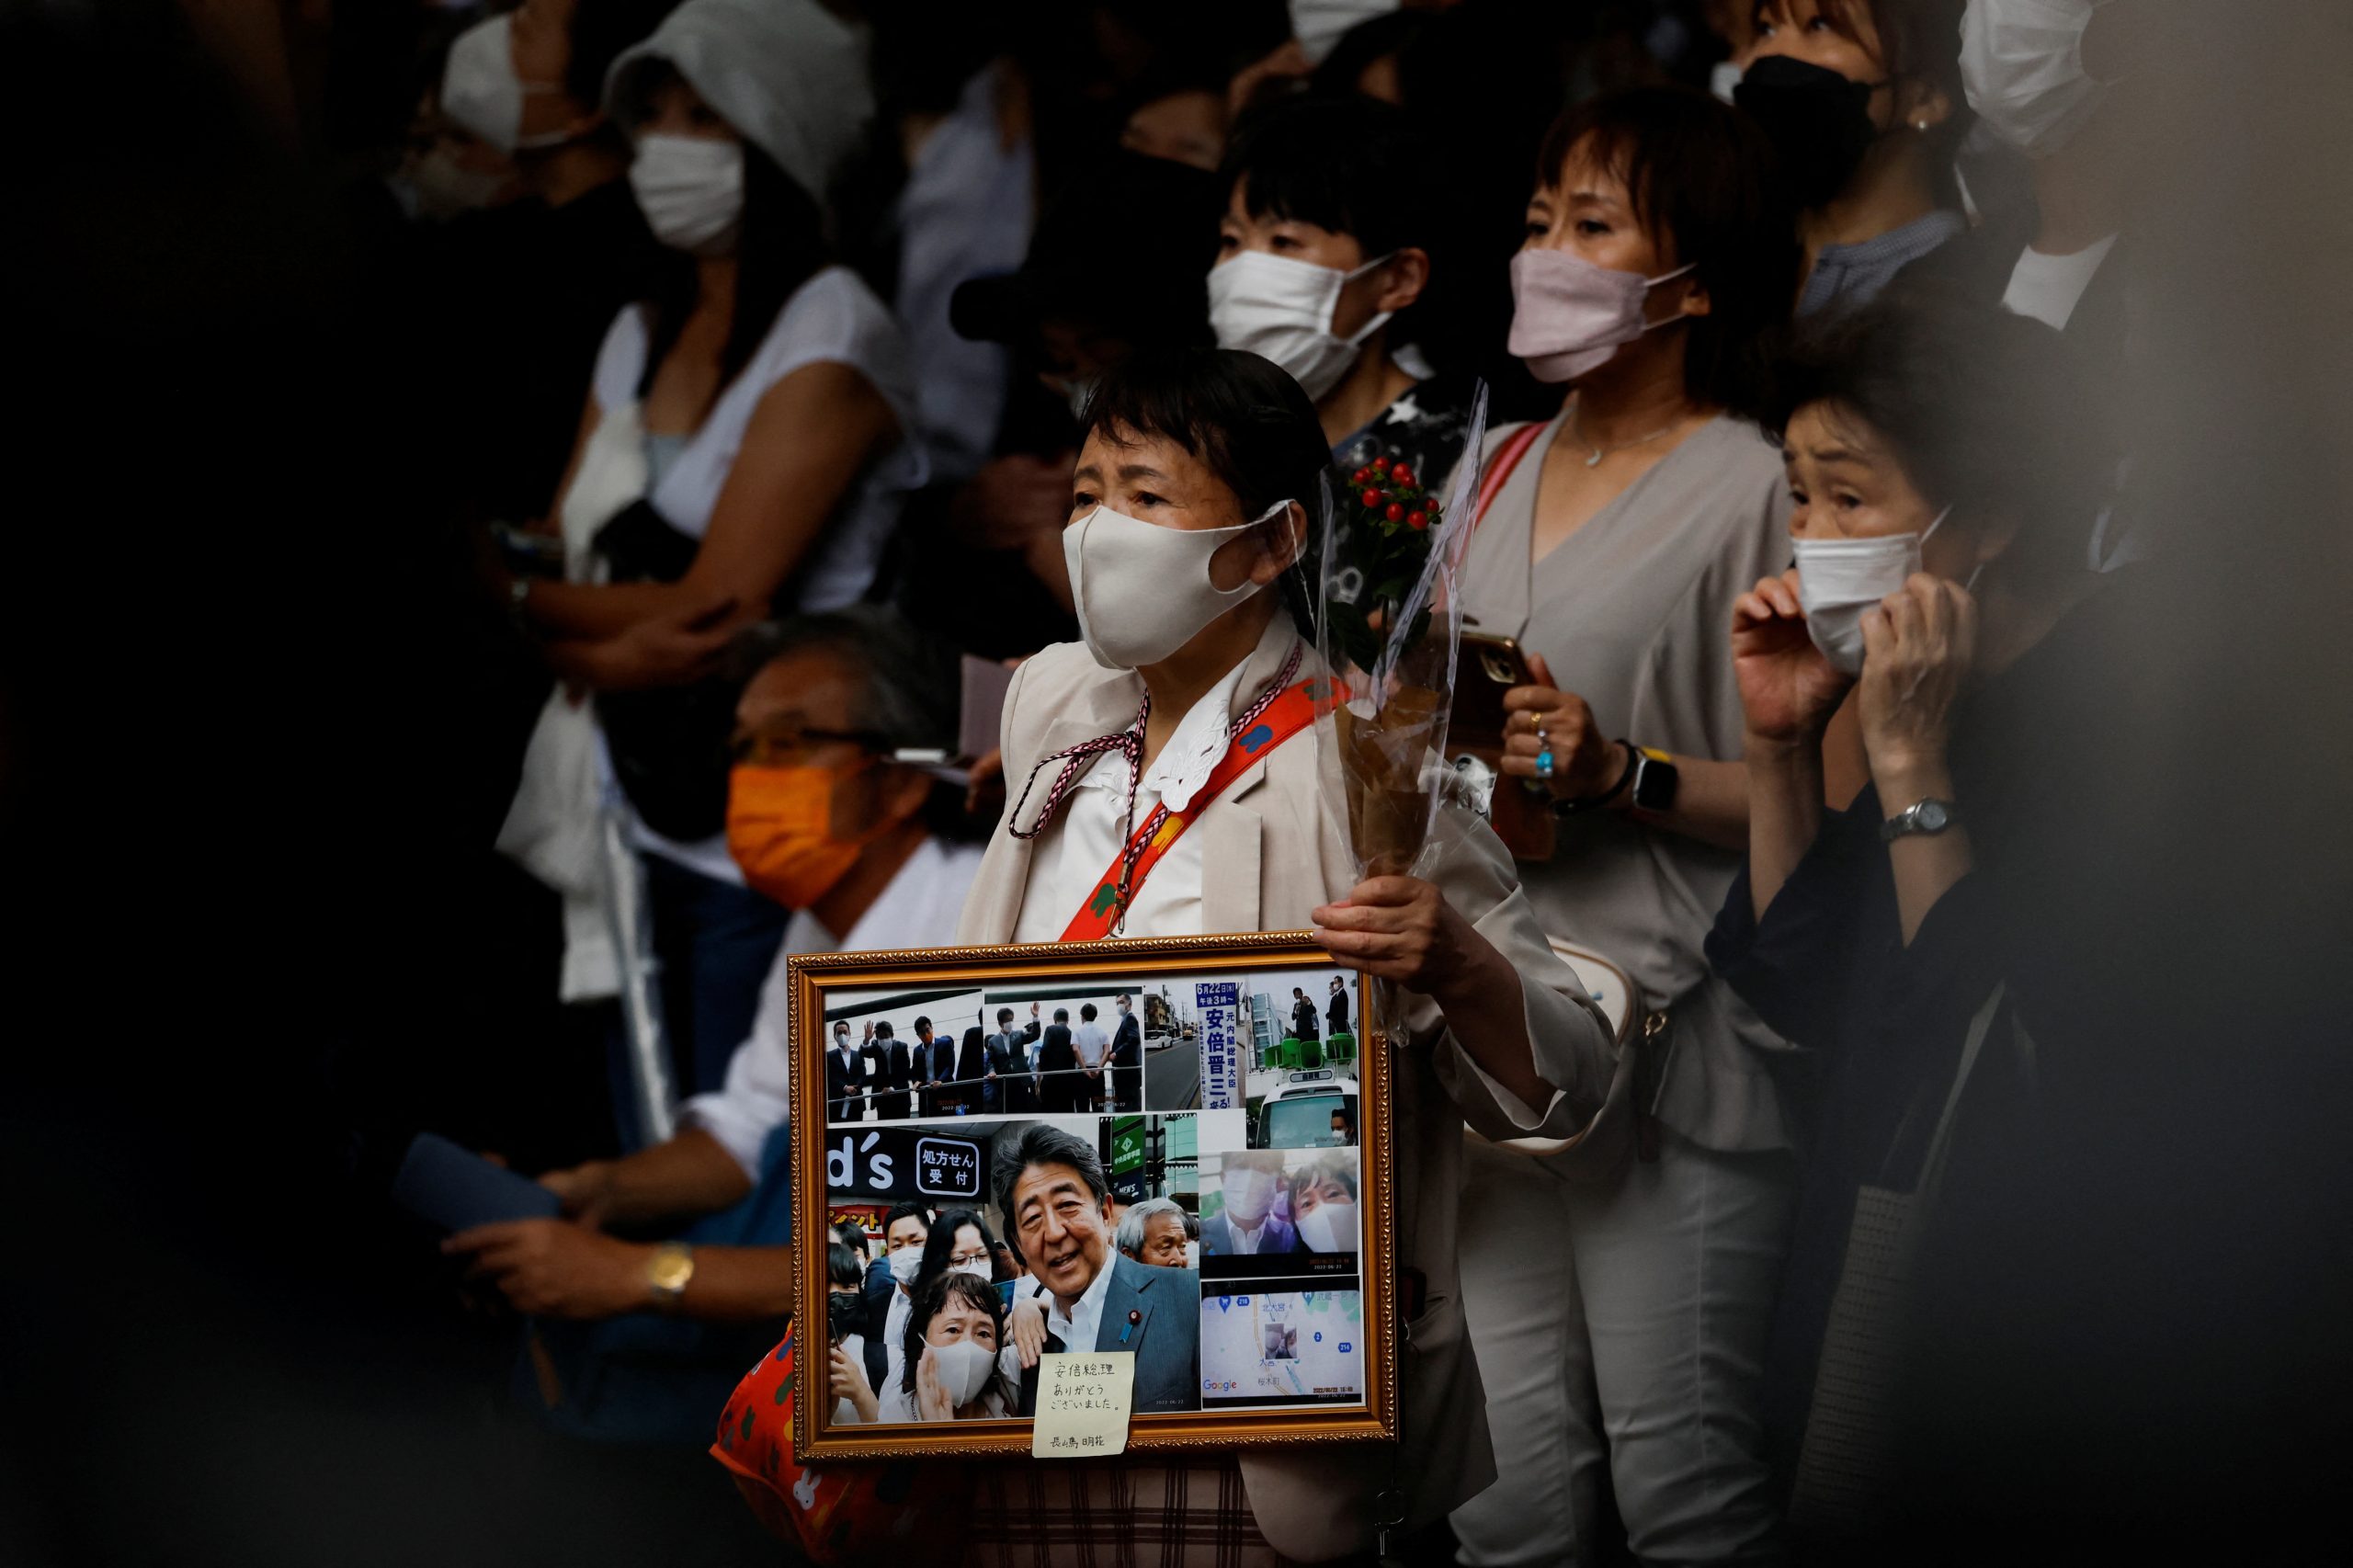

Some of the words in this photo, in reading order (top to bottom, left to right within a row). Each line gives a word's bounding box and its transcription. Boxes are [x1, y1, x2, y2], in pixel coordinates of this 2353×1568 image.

[1206, 1008, 1226, 1096] 安倍晋三
[1226, 1012, 1236, 1088] 元内閣総理大臣
[922, 1148, 974, 1169] 処方せん
[828, 1210, 879, 1230] イント
[1054, 1361, 1115, 1378] 安倍総理
[1053, 1382, 1104, 1396] ありがとう
[1203, 1379, 1237, 1392] Google
[1051, 1399, 1119, 1411] ございました。
